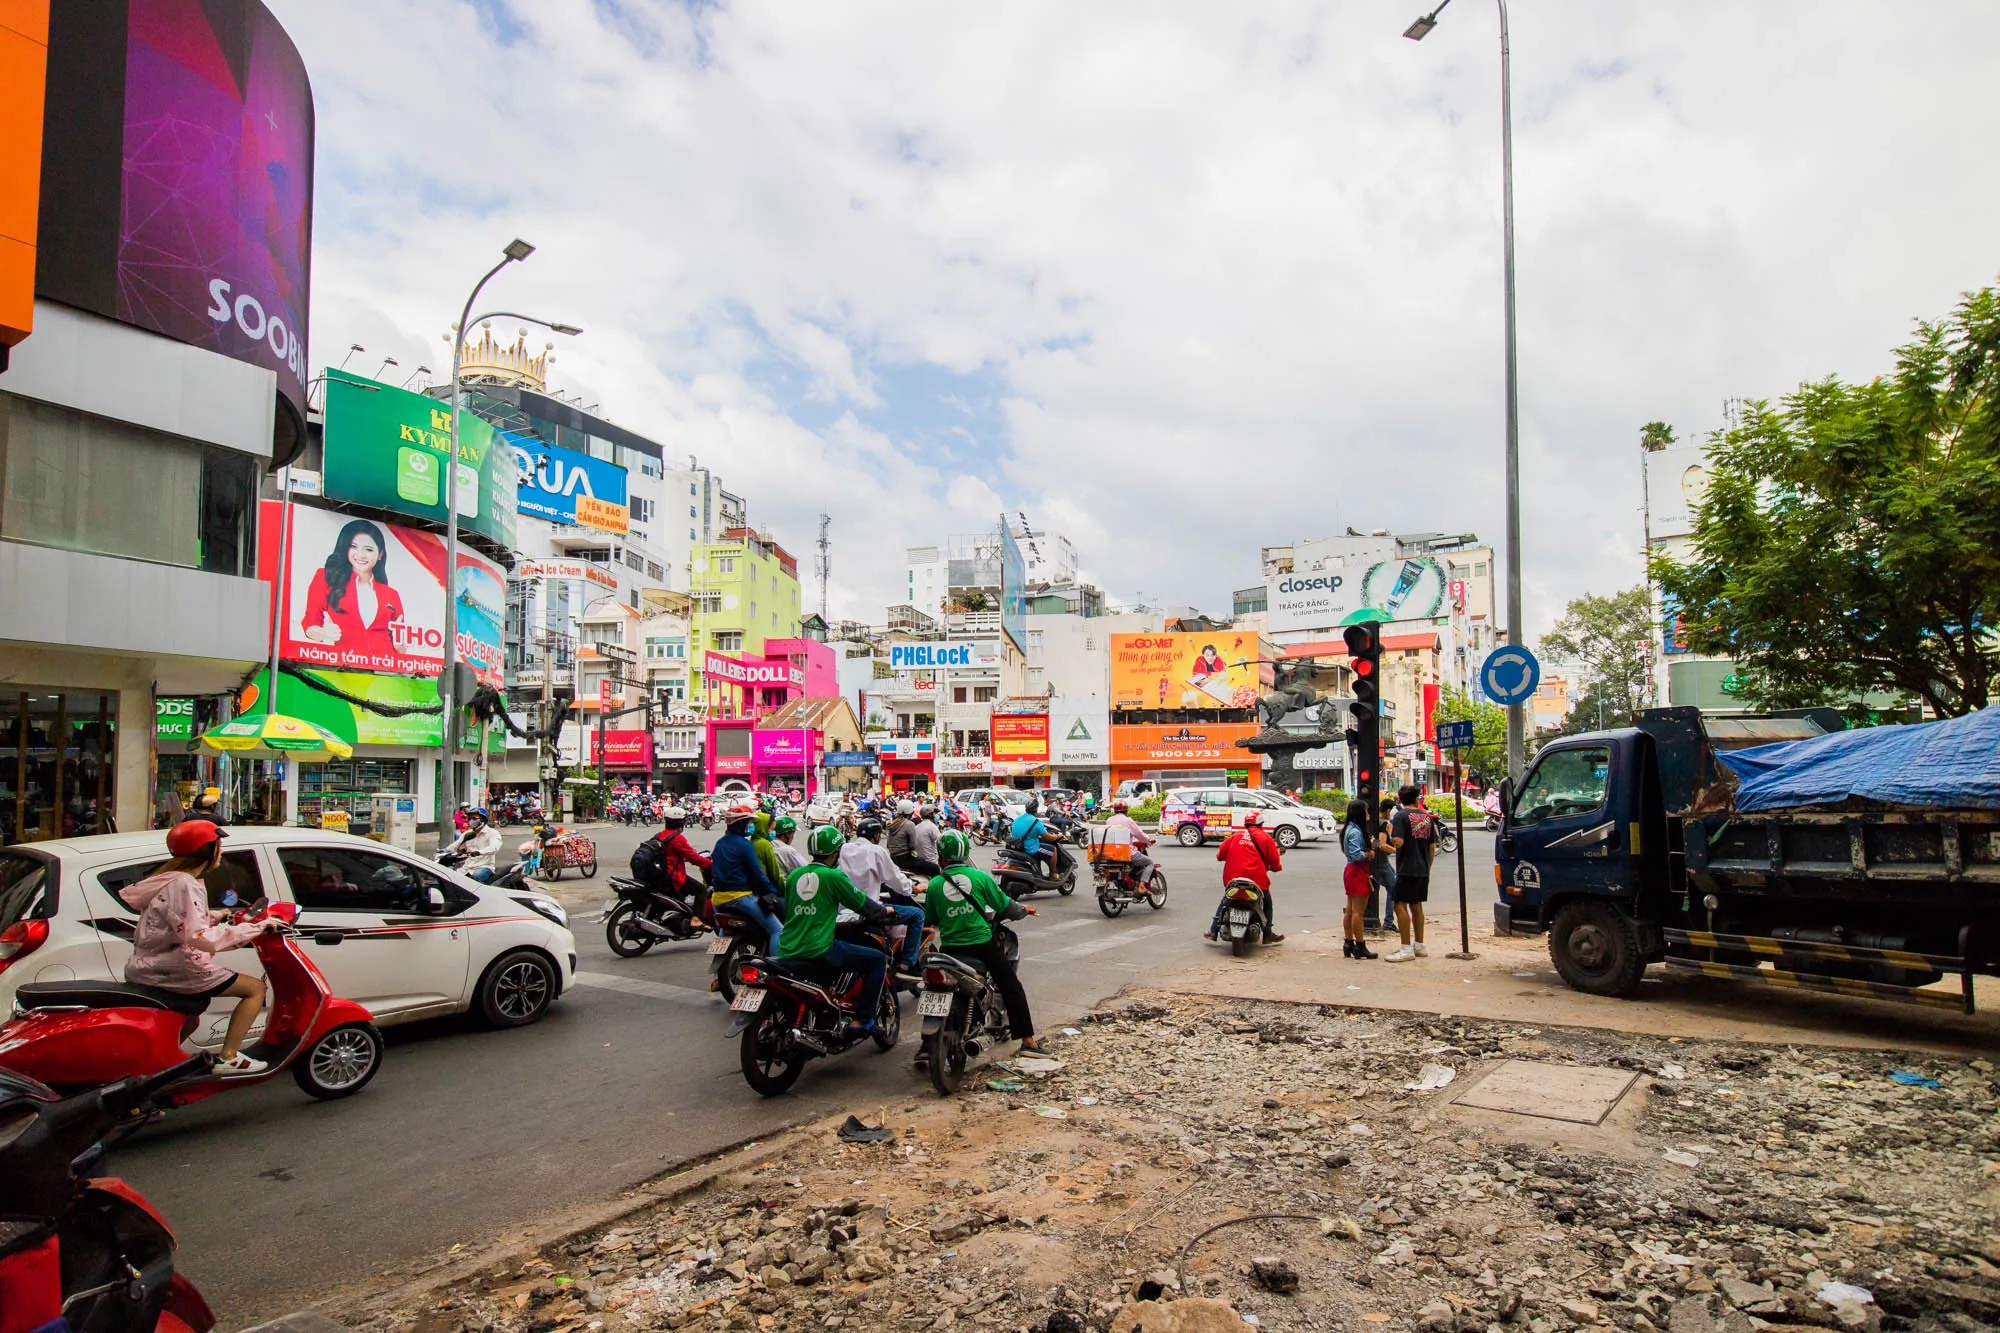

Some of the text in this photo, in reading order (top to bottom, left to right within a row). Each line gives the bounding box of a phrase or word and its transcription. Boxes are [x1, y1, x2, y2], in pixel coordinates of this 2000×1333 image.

[558, 563, 582, 577] Cream
[1278, 575, 1343, 593] closeup
[299, 646, 338, 664] Nâng
[341, 649, 368, 665] tầm
[397, 658, 443, 673] nghiệm
[747, 666, 788, 683] DOLL
[913, 678, 936, 690] tea
[655, 714, 702, 727] HOTEL
[157, 723, 183, 735] HỰC
[1150, 750, 1221, 758] 1900 6733
[1296, 757, 1343, 768] COFFEE
[793, 903, 817, 916] Grab
[946, 902, 974, 918] Grab
